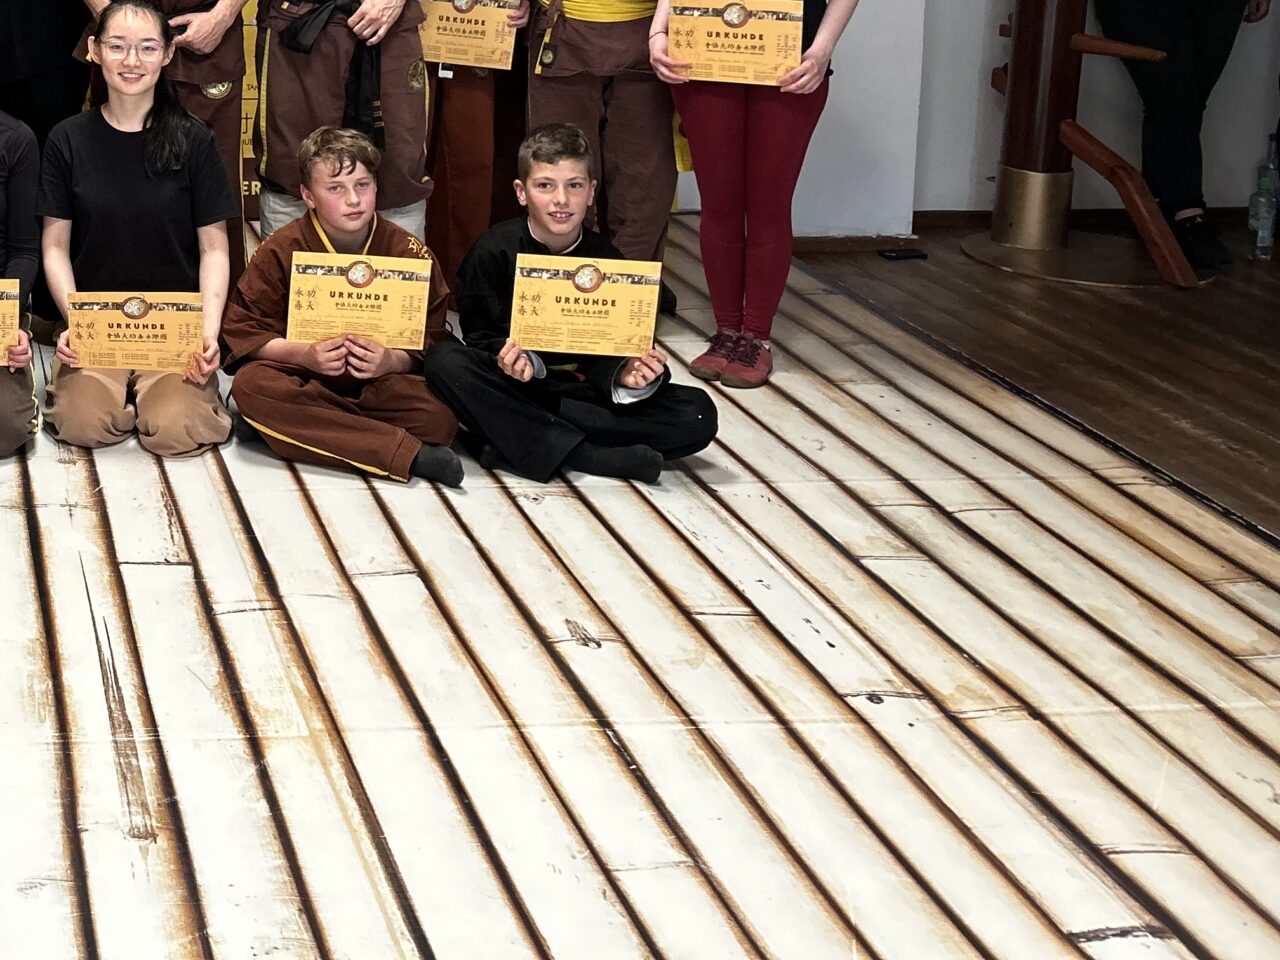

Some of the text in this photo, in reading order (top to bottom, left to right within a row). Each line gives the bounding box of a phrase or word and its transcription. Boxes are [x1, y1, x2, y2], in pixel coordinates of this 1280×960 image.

[438, 15, 486, 26] URKUNDE
[707, 31, 764, 40] URKUNDE
[329, 291, 388, 301] URKUNDE
[555, 296, 616, 307] URKUNDE
[108, 322, 165, 330] URKUNDE
